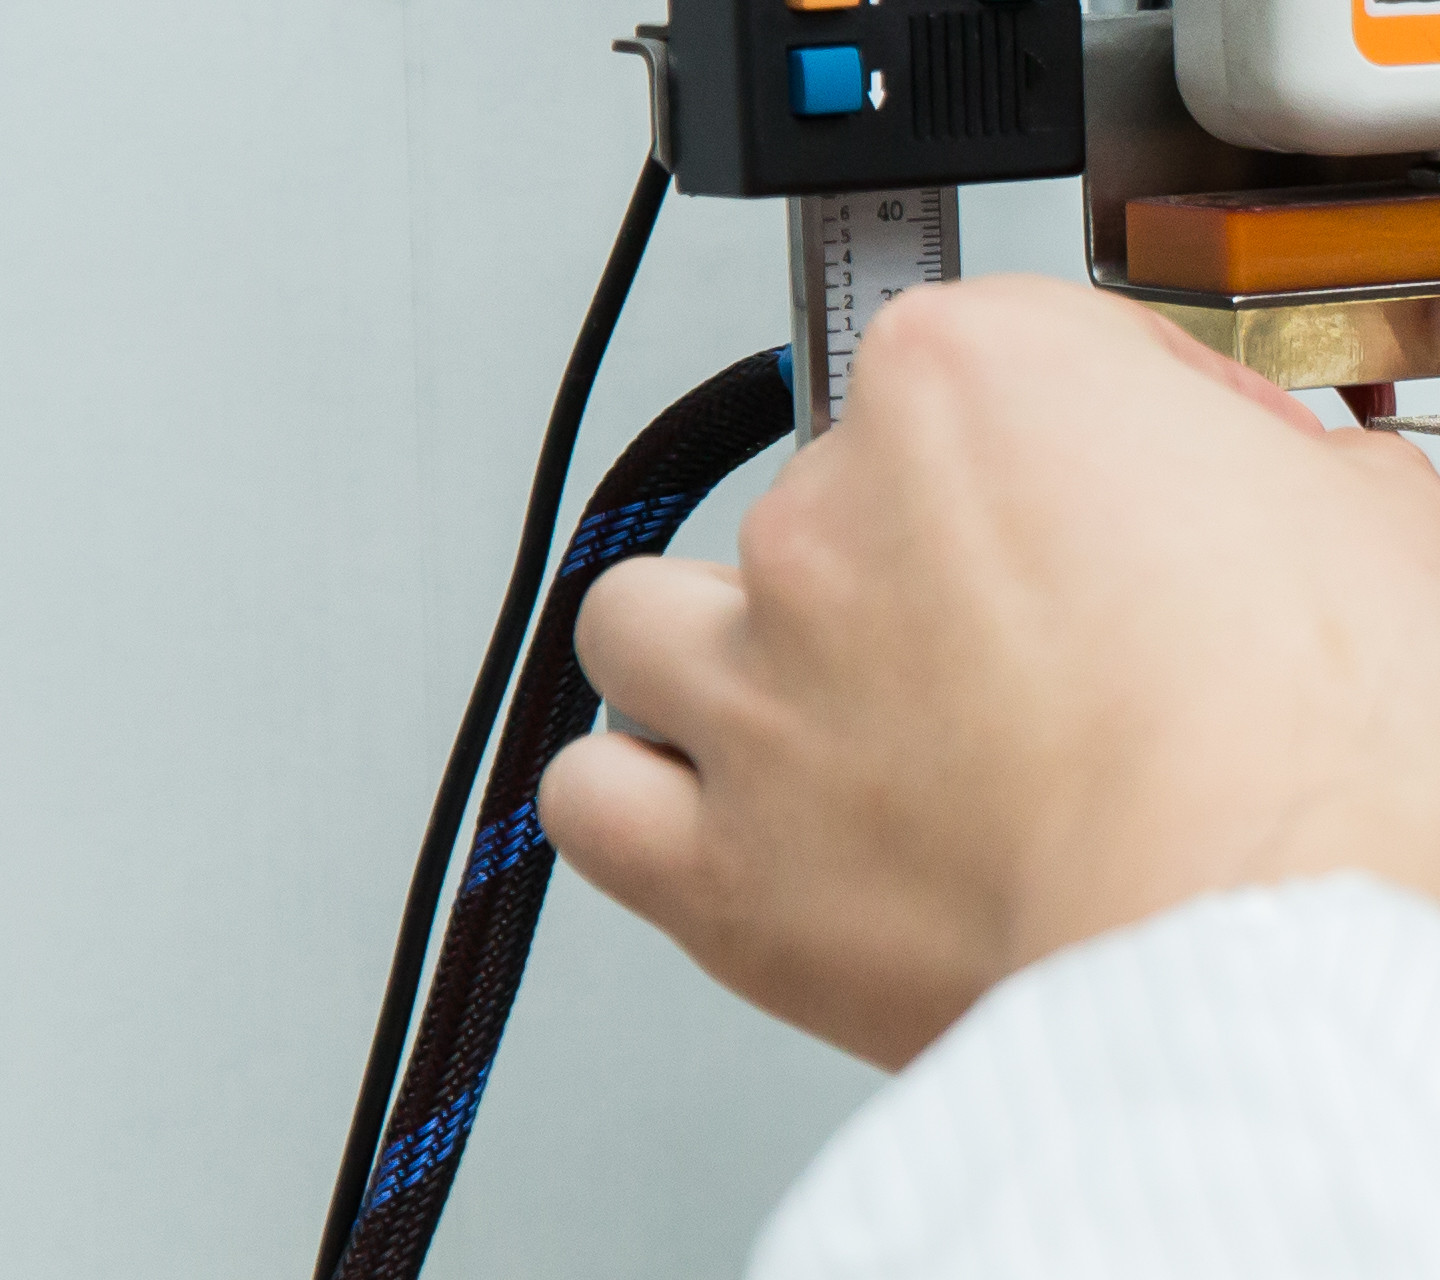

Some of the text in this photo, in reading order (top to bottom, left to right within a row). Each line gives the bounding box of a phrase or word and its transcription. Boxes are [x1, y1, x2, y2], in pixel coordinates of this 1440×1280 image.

[840, 206, 850, 220] 6
[876, 200, 904, 222] 40
[840, 229, 850, 243] 5
[842, 248, 852, 265] 4
[842, 273, 852, 287] 3
[844, 294, 854, 310] 2
[844, 317, 854, 331] 1
